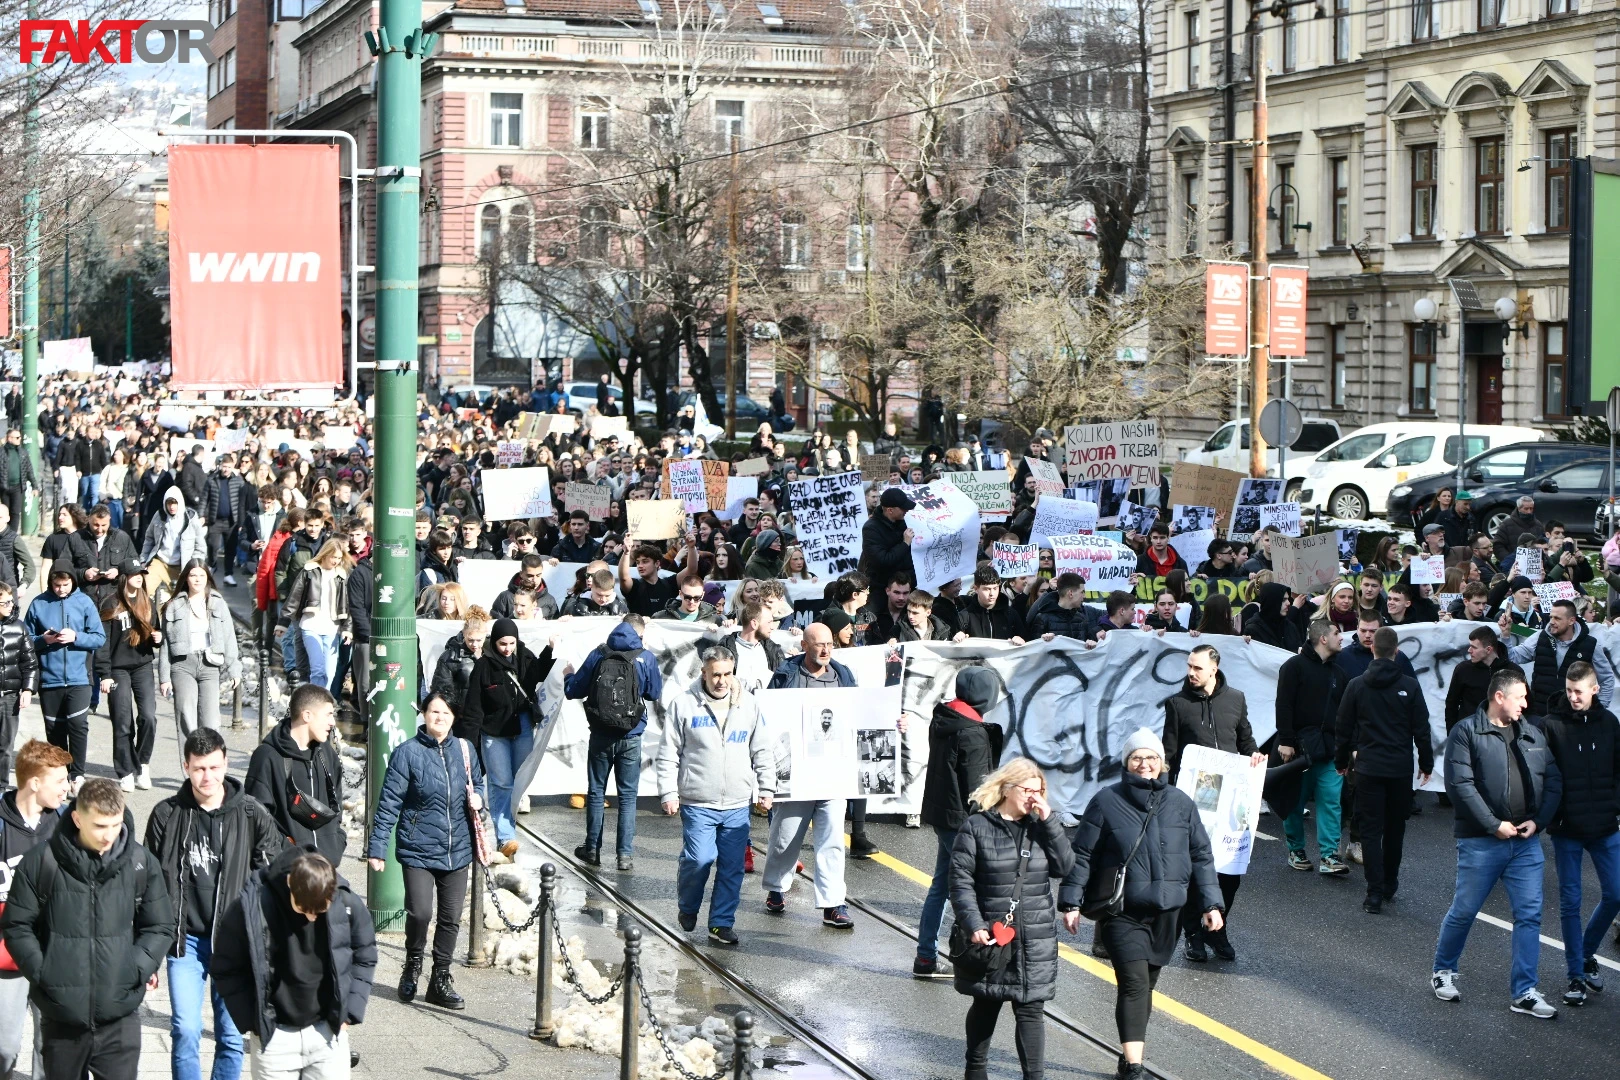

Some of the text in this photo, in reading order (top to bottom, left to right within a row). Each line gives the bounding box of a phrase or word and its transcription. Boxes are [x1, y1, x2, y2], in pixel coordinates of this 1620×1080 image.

[188, 251, 321, 283] wwin
[1067, 422, 1155, 446] KOLIKO NAŠIH
[1069, 443, 1158, 466] ŽIVOTA TREBA
[726, 730, 748, 744] AIR
